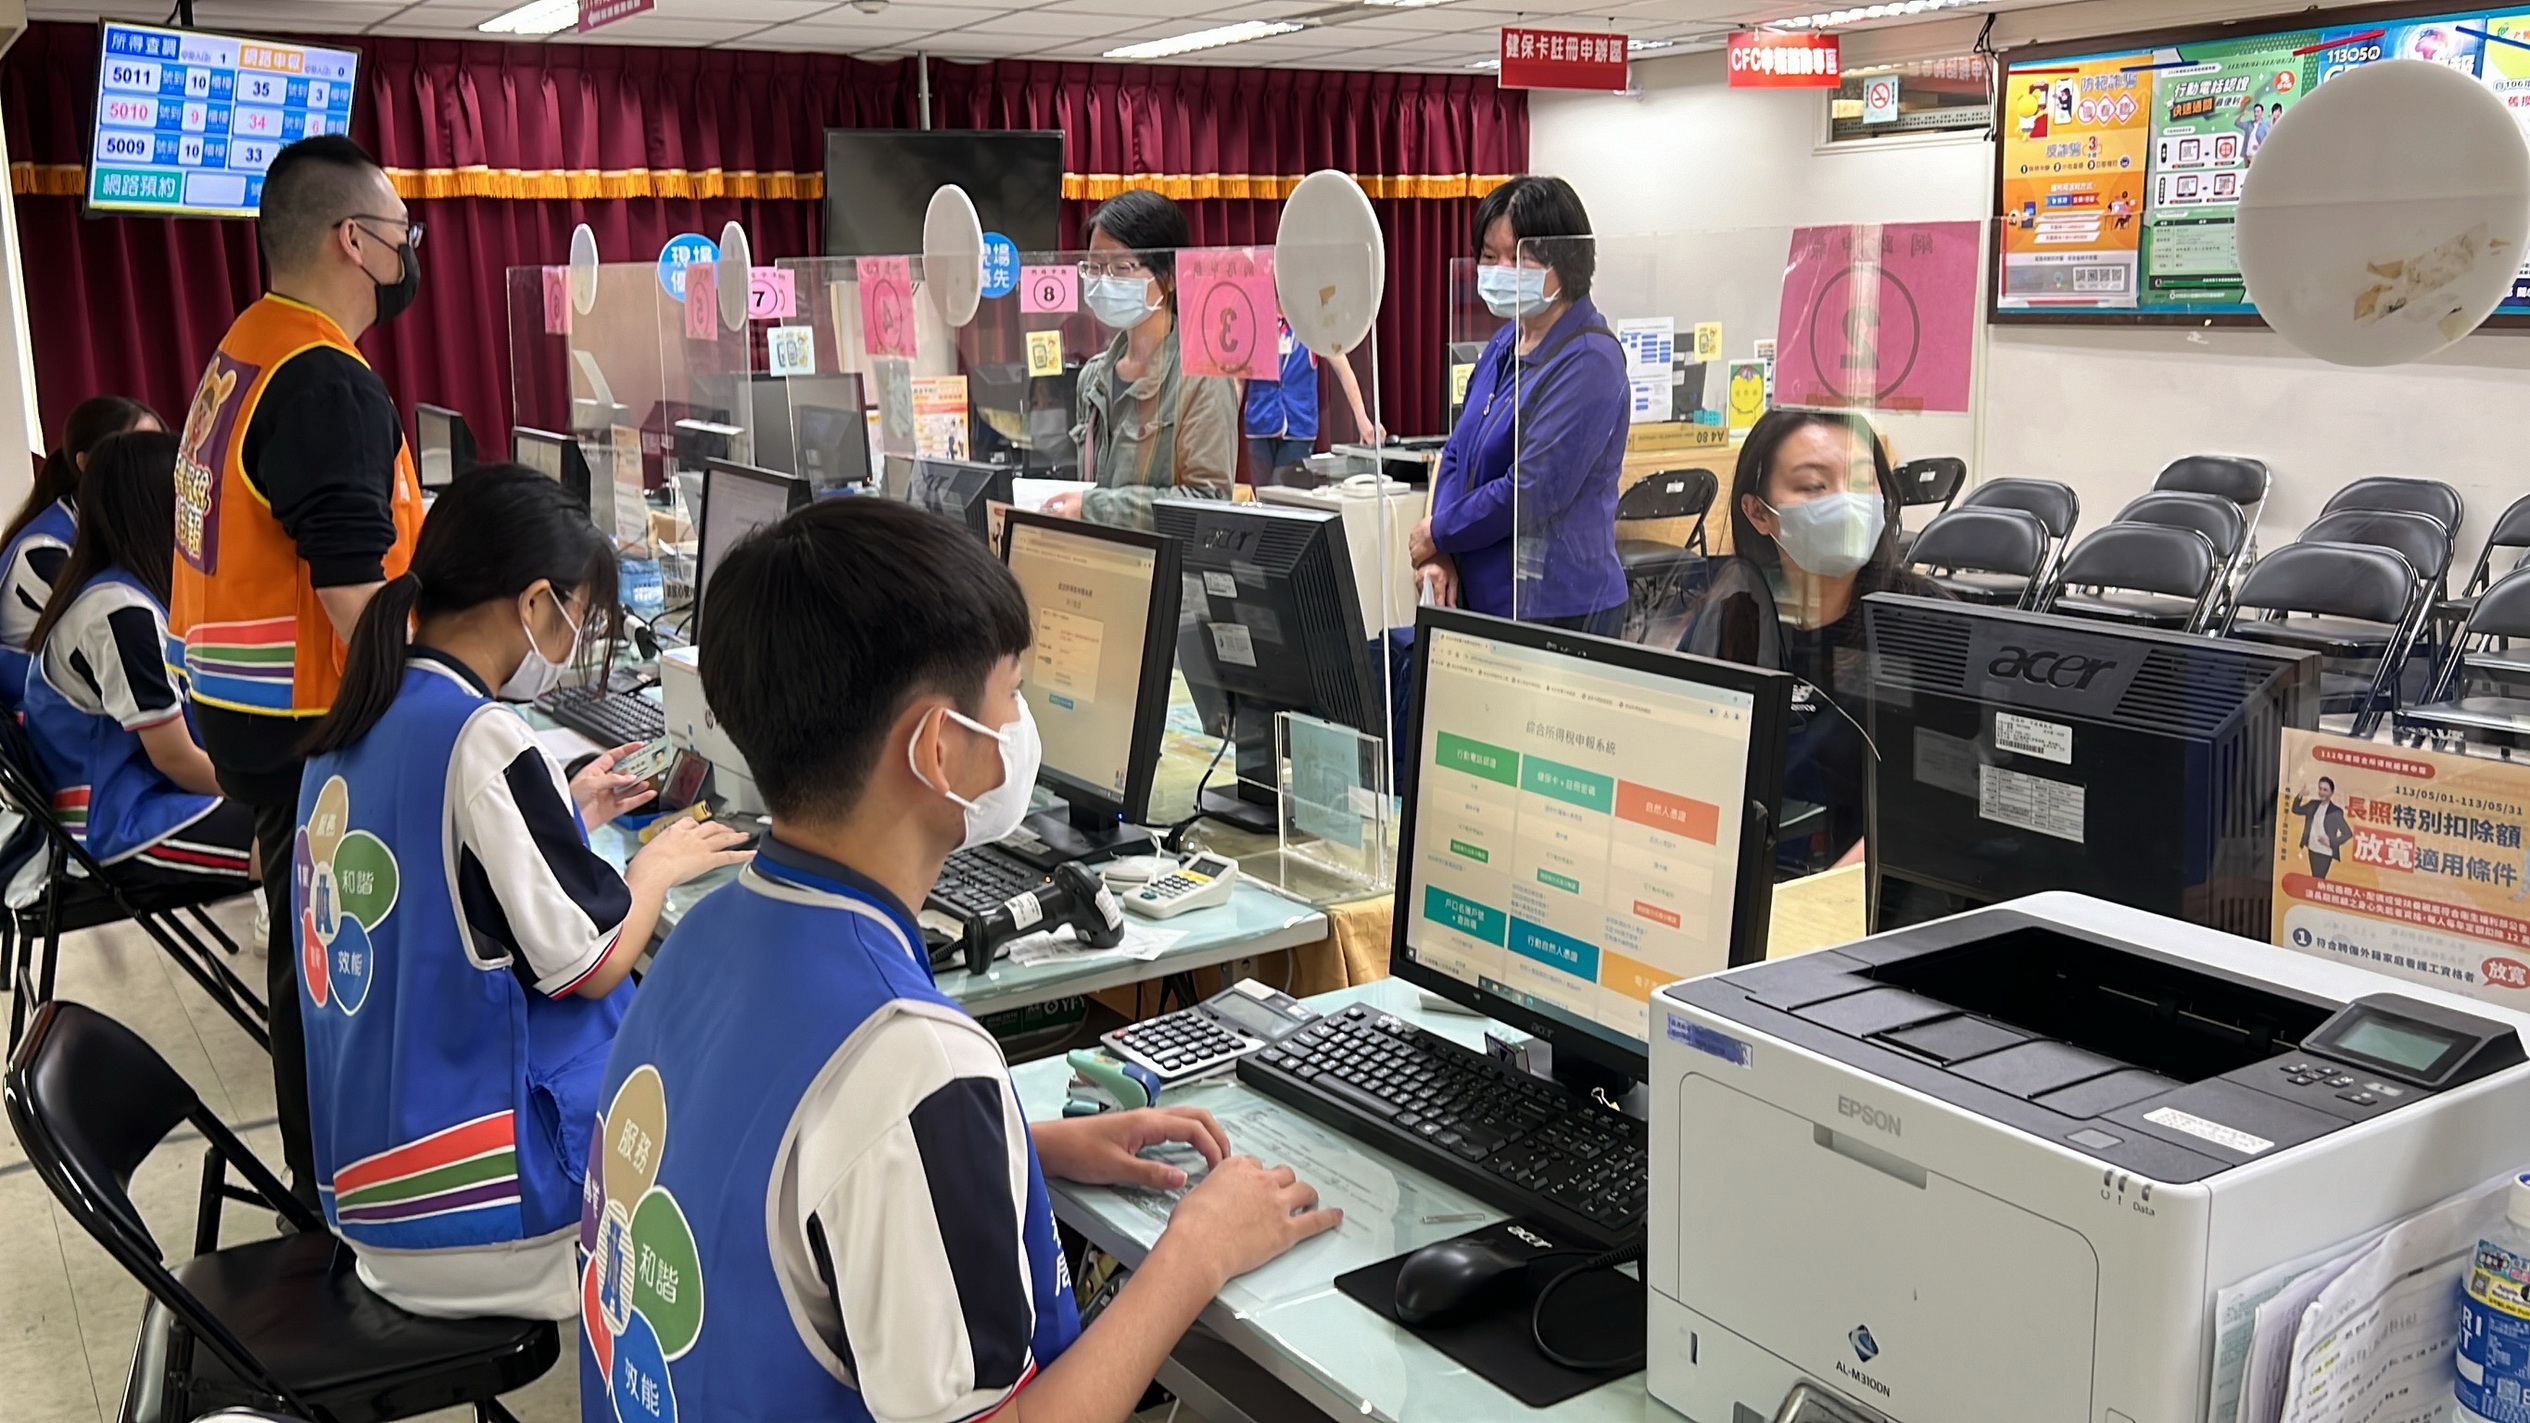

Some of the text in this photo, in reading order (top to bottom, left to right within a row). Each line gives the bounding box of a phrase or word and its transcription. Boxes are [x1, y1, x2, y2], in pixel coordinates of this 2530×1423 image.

[1505, 33, 1623, 63] 健保卡註冊申辦區
[112, 66, 150, 85] 5011
[192, 74, 207, 90] 10
[252, 80, 270, 98] 35
[315, 88, 323, 101] 3
[110, 103, 149, 121] 5010
[190, 111, 199, 125] 9
[249, 113, 267, 130] 34
[106, 137, 146, 156] 5009
[185, 144, 199, 158] 10
[245, 147, 263, 163] 33
[2088, 136, 2097, 150] 3
[102, 173, 176, 199] 網路預約
[670, 244, 713, 266] 現場
[752, 290, 766, 308] 7
[1043, 285, 1055, 302] 8
[1696, 431, 1708, 444] 80
[1711, 430, 1725, 443] A4
[1987, 645, 2118, 692] acer
[1525, 719, 1616, 756] 綜合所得稅申報系統
[2394, 785, 2523, 816] 113/05/01-113/05/31
[2344, 795, 2522, 850] 長照特別扣除額
[2353, 831, 2518, 888] 放寬適用條件
[342, 869, 375, 895] 和諧
[338, 950, 363, 977] 效能
[2488, 960, 2526, 986] 放寬
[1838, 1094, 1902, 1138] EPSON
[616, 1117, 653, 1175] 服務
[2132, 1201, 2156, 1217] Data
[1507, 1224, 1553, 1248] acer
[638, 1241, 680, 1305] 和諧
[623, 1355, 661, 1418] 效能
[1835, 1360, 1891, 1398] AL-M310DN
